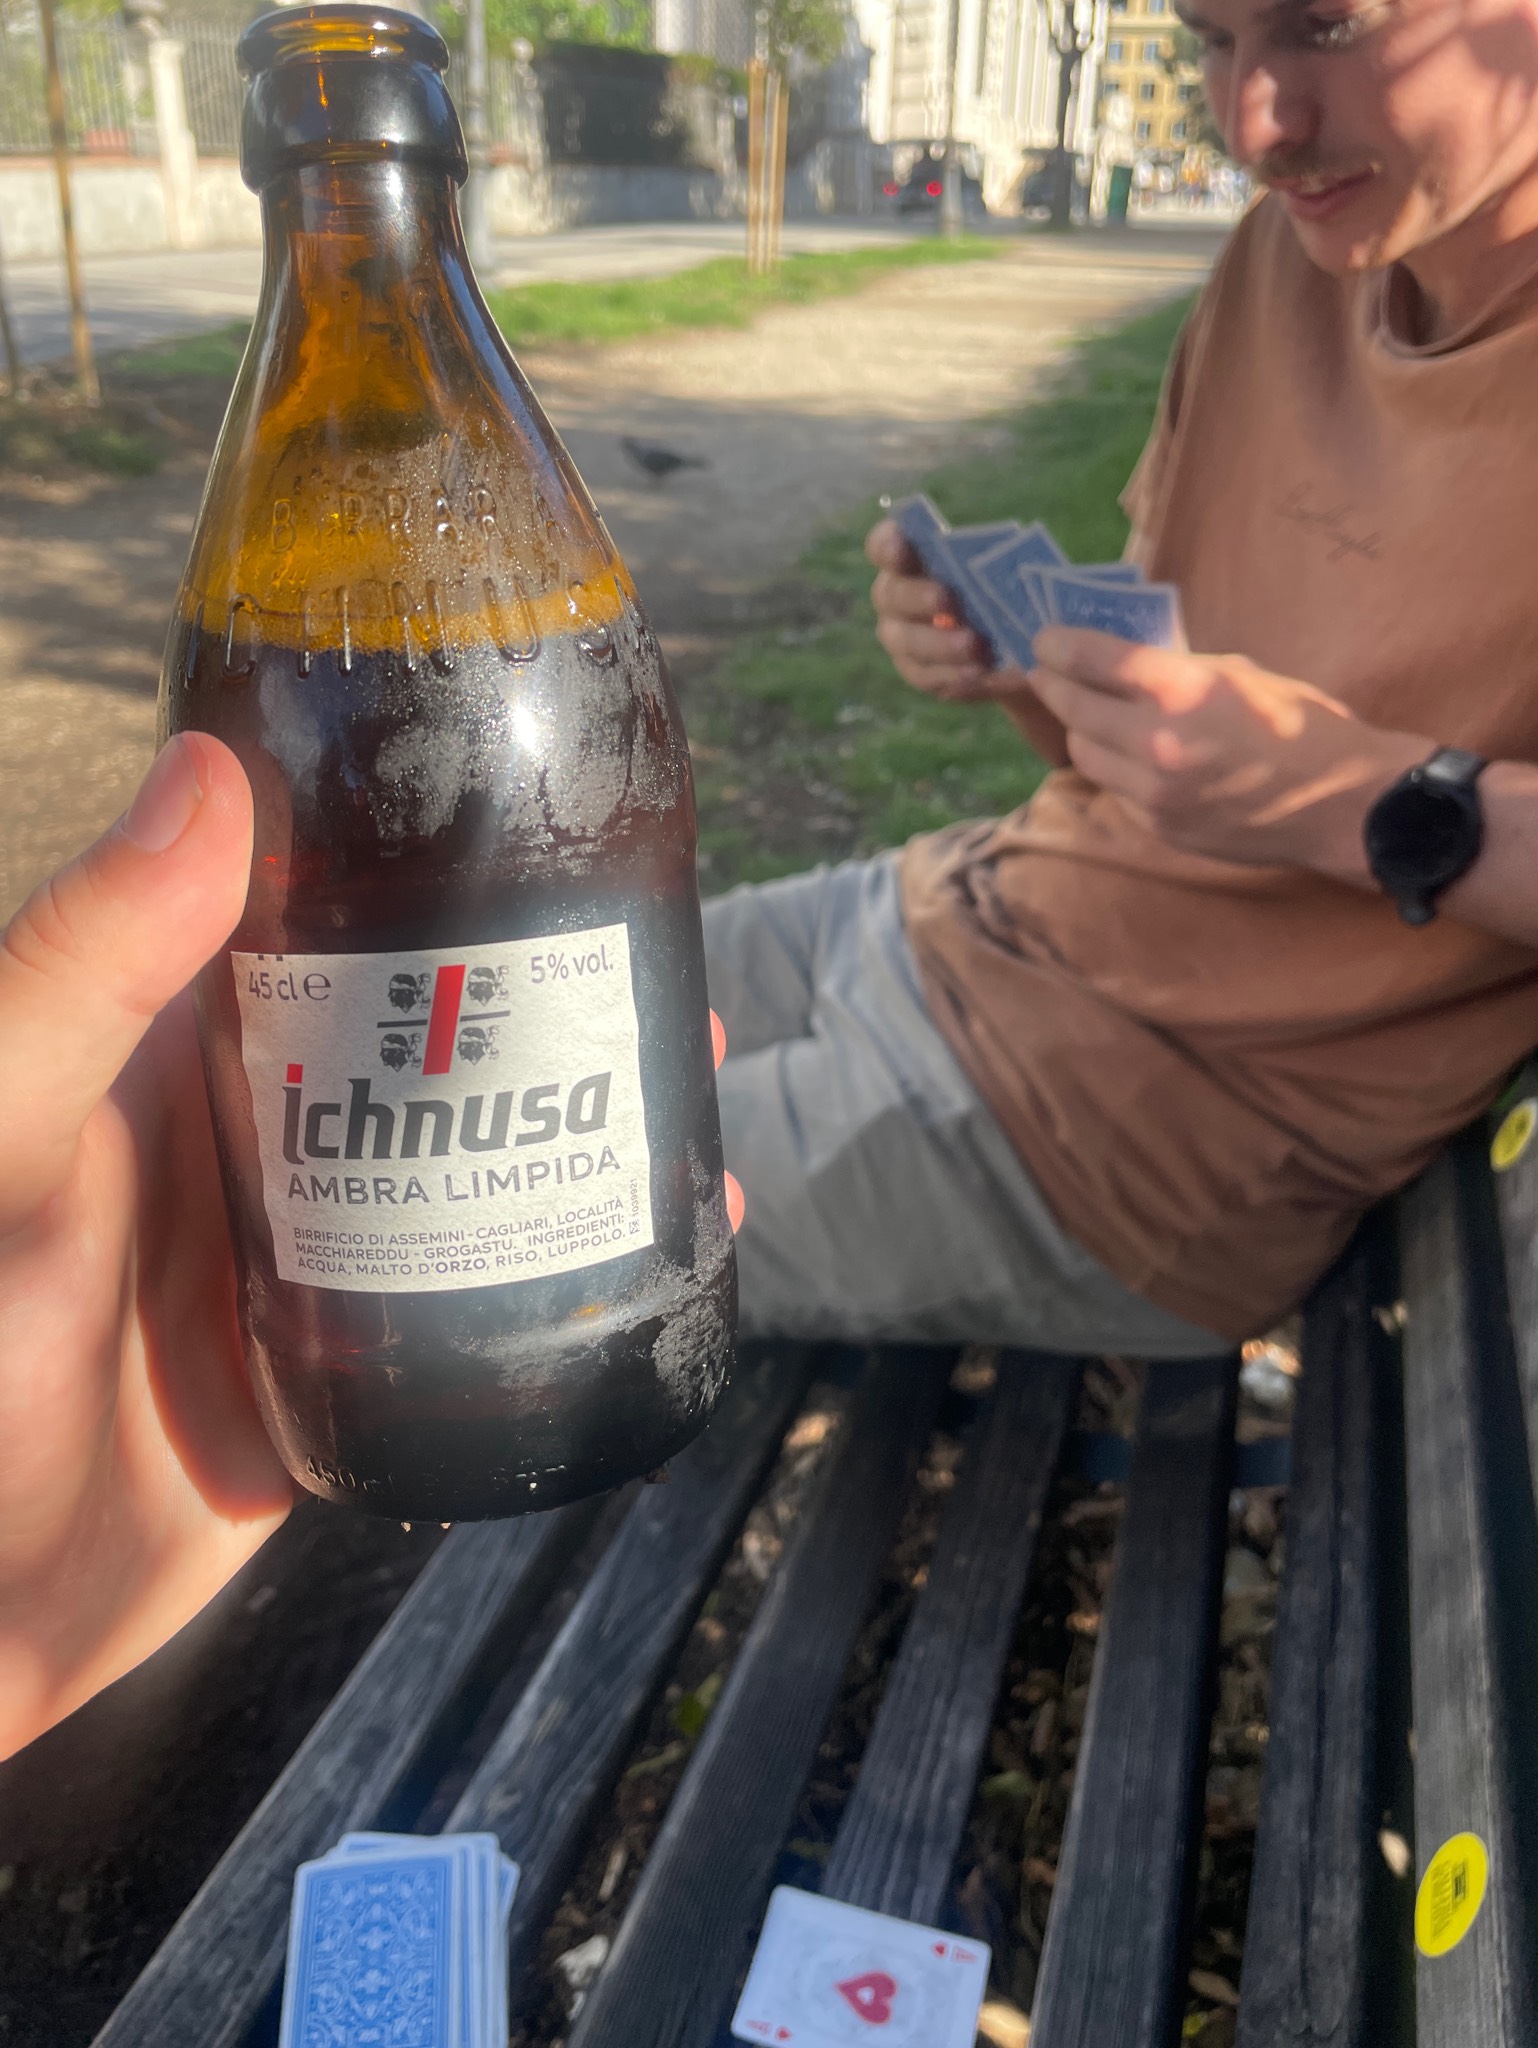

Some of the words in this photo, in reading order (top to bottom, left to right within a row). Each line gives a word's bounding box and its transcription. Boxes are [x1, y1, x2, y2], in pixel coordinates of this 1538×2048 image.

[248, 971, 272, 1001] 45
[277, 971, 298, 1002] cl
[530, 953, 569, 985] 5%
[573, 943, 614, 977] vol.
[281, 1063, 613, 1166] ichnusa
[287, 1173, 431, 1205] AMBRA
[444, 1145, 621, 1202] LIMPIDA
[629, 1177, 640, 1218] 1039921
[293, 1227, 364, 1245] BIRRIFICIO
[369, 1233, 384, 1246] DI
[557, 1195, 624, 1225] LOCALITÀ
[295, 1242, 410, 1261] MACCHIAREDDU
[424, 1238, 518, 1260] GROGASTU.
[527, 1213, 626, 1247] INGREDIENTI:
[297, 1257, 352, 1276] ACQUA,
[356, 1263, 412, 1276] MALTO
[495, 1250, 543, 1267] RISO,
[547, 1228, 626, 1259] LUPPOLO.
